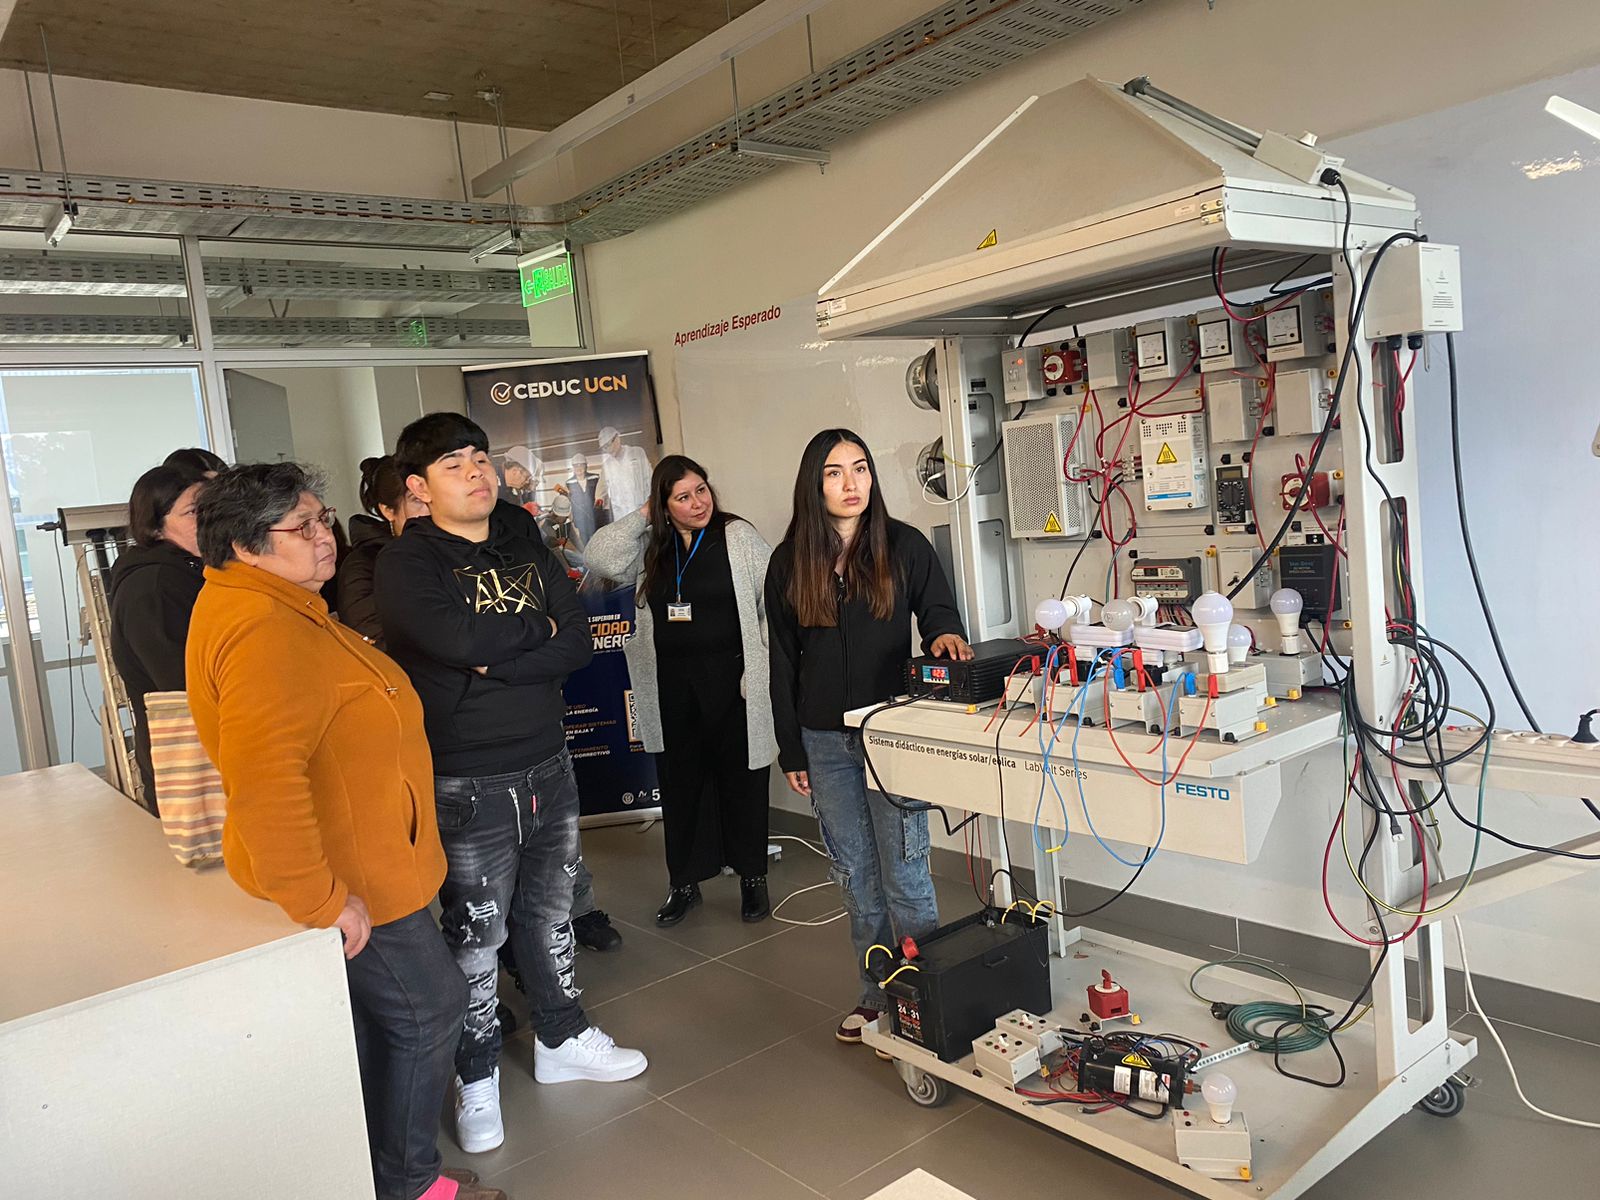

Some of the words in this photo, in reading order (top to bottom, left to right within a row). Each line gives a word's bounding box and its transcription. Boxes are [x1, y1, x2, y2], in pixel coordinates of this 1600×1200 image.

[674, 319, 729, 347] Aprendizaje
[732, 305, 781, 330] Esperado
[513, 379, 581, 399] CEDUC
[584, 374, 628, 393] UCN
[591, 633, 632, 650] NERG
[574, 707, 599, 715] ENERGÍA
[868, 735, 894, 748] Sistema
[894, 740, 926, 753] didáctico
[926, 746, 935, 755] en
[936, 748, 967, 761] energías
[1060, 766, 1088, 780] Series
[1175, 782, 1230, 801] FESTO
